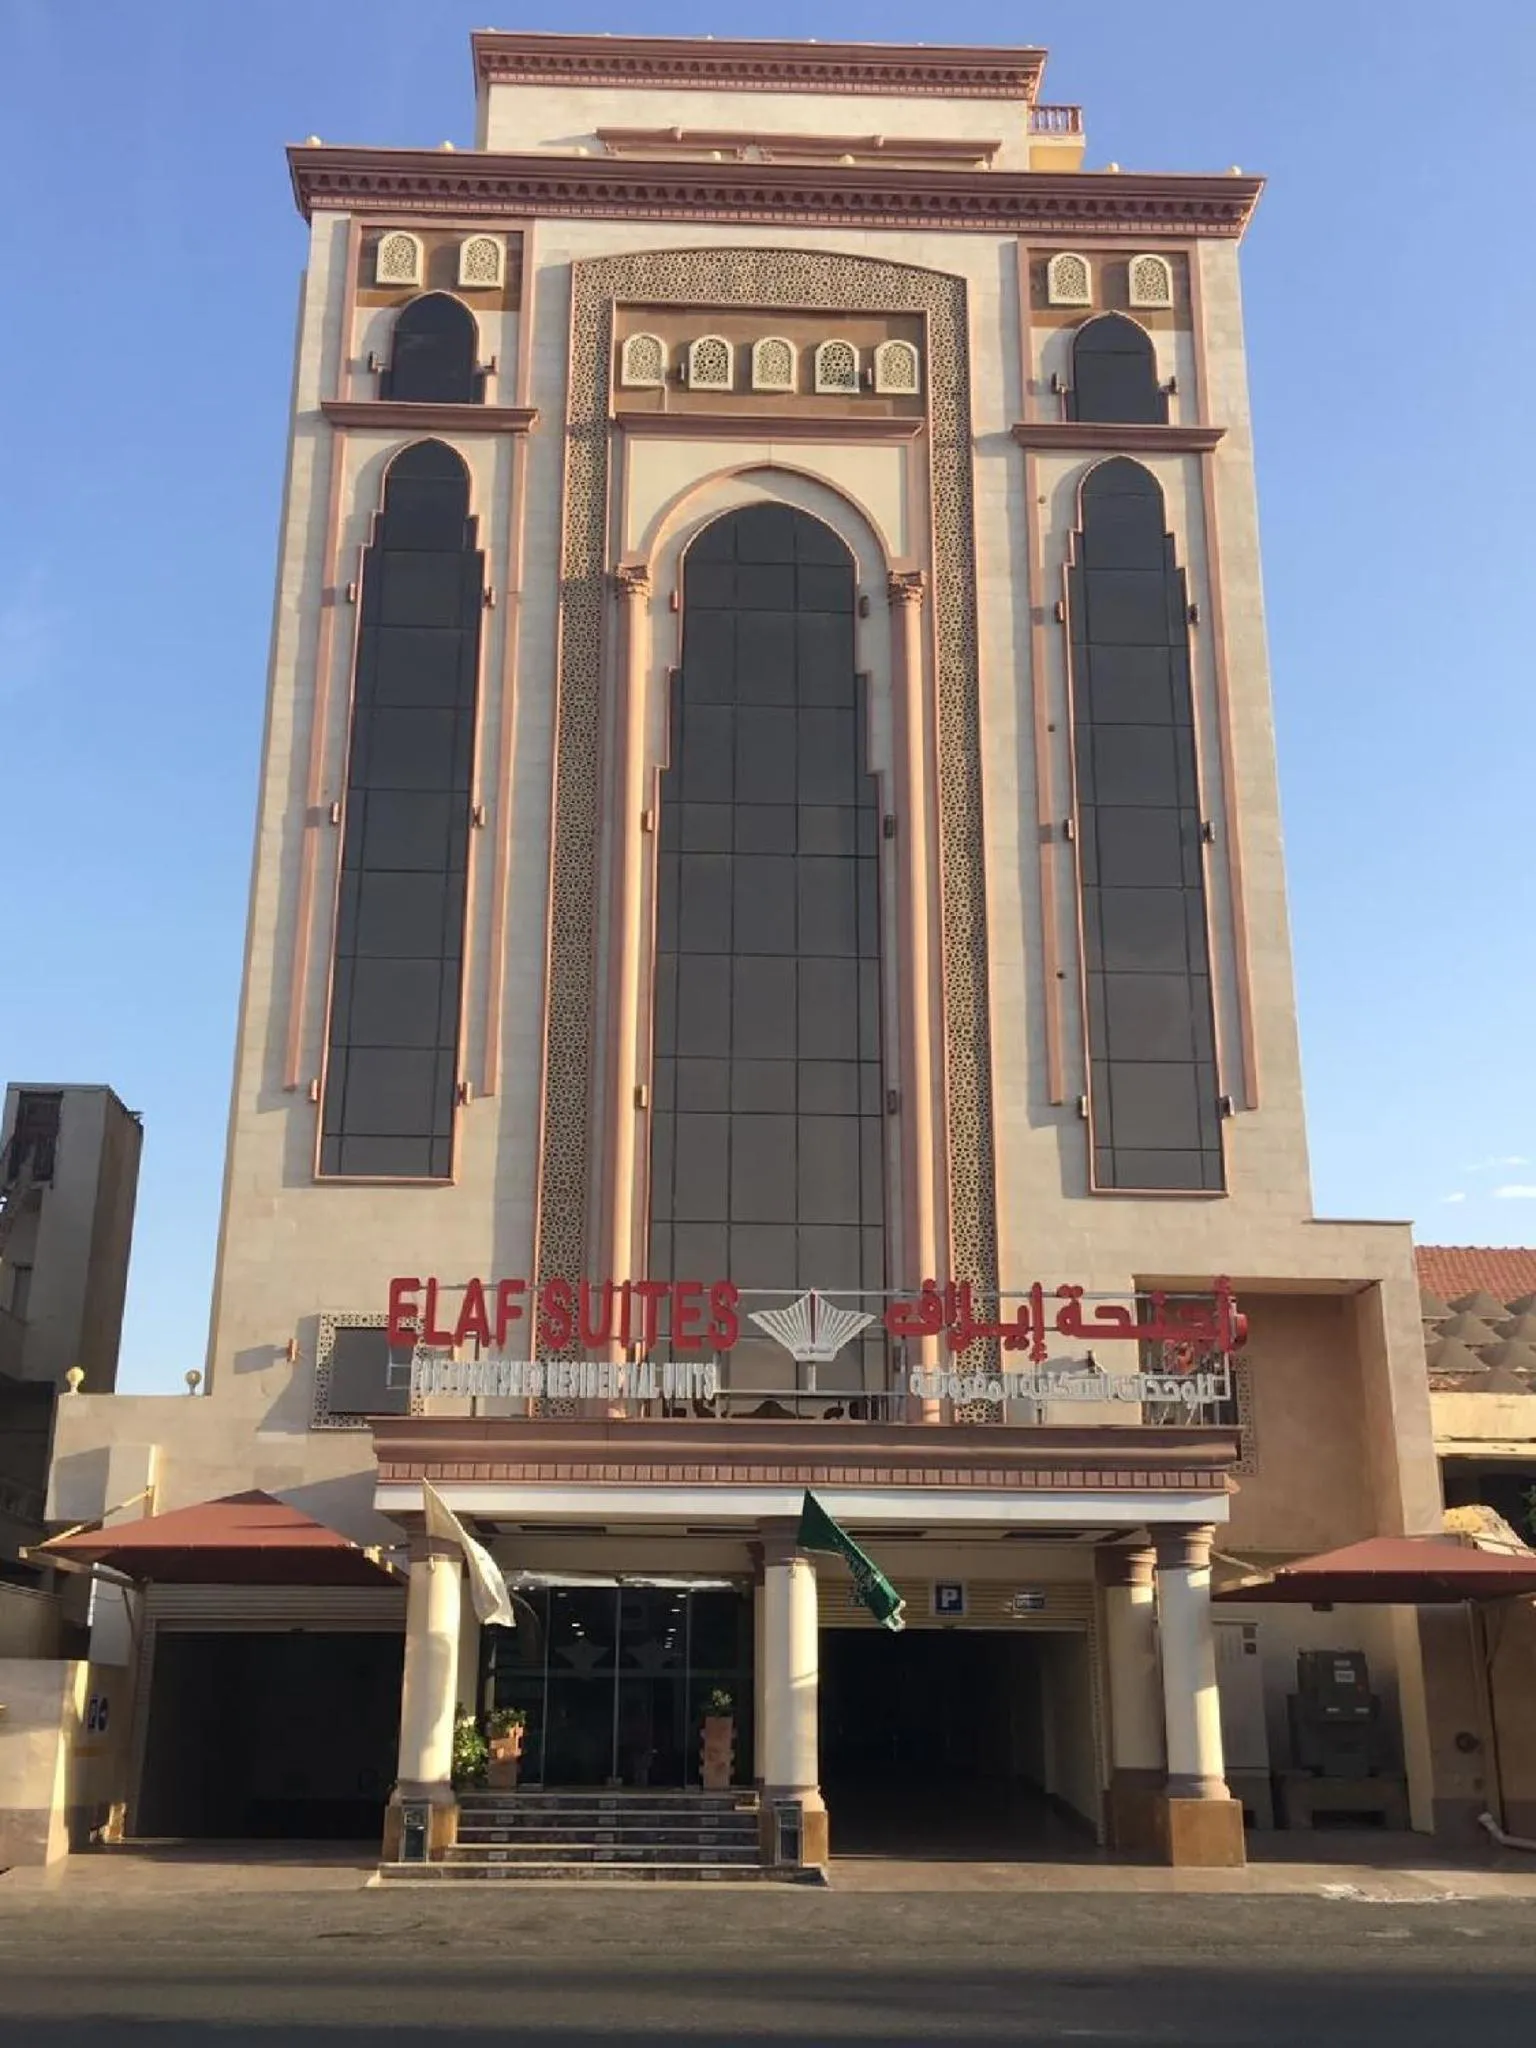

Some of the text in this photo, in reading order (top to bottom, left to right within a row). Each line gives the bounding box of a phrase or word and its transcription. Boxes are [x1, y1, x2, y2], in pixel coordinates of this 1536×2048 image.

[387, 1277, 740, 1352] ELAF SUITES
[885, 1278, 1048, 1363] إيلاف
[547, 1361, 660, 1399] RESIDENTIAL
[663, 1362, 715, 1400] UNITS
[941, 1588, 959, 1609] P
